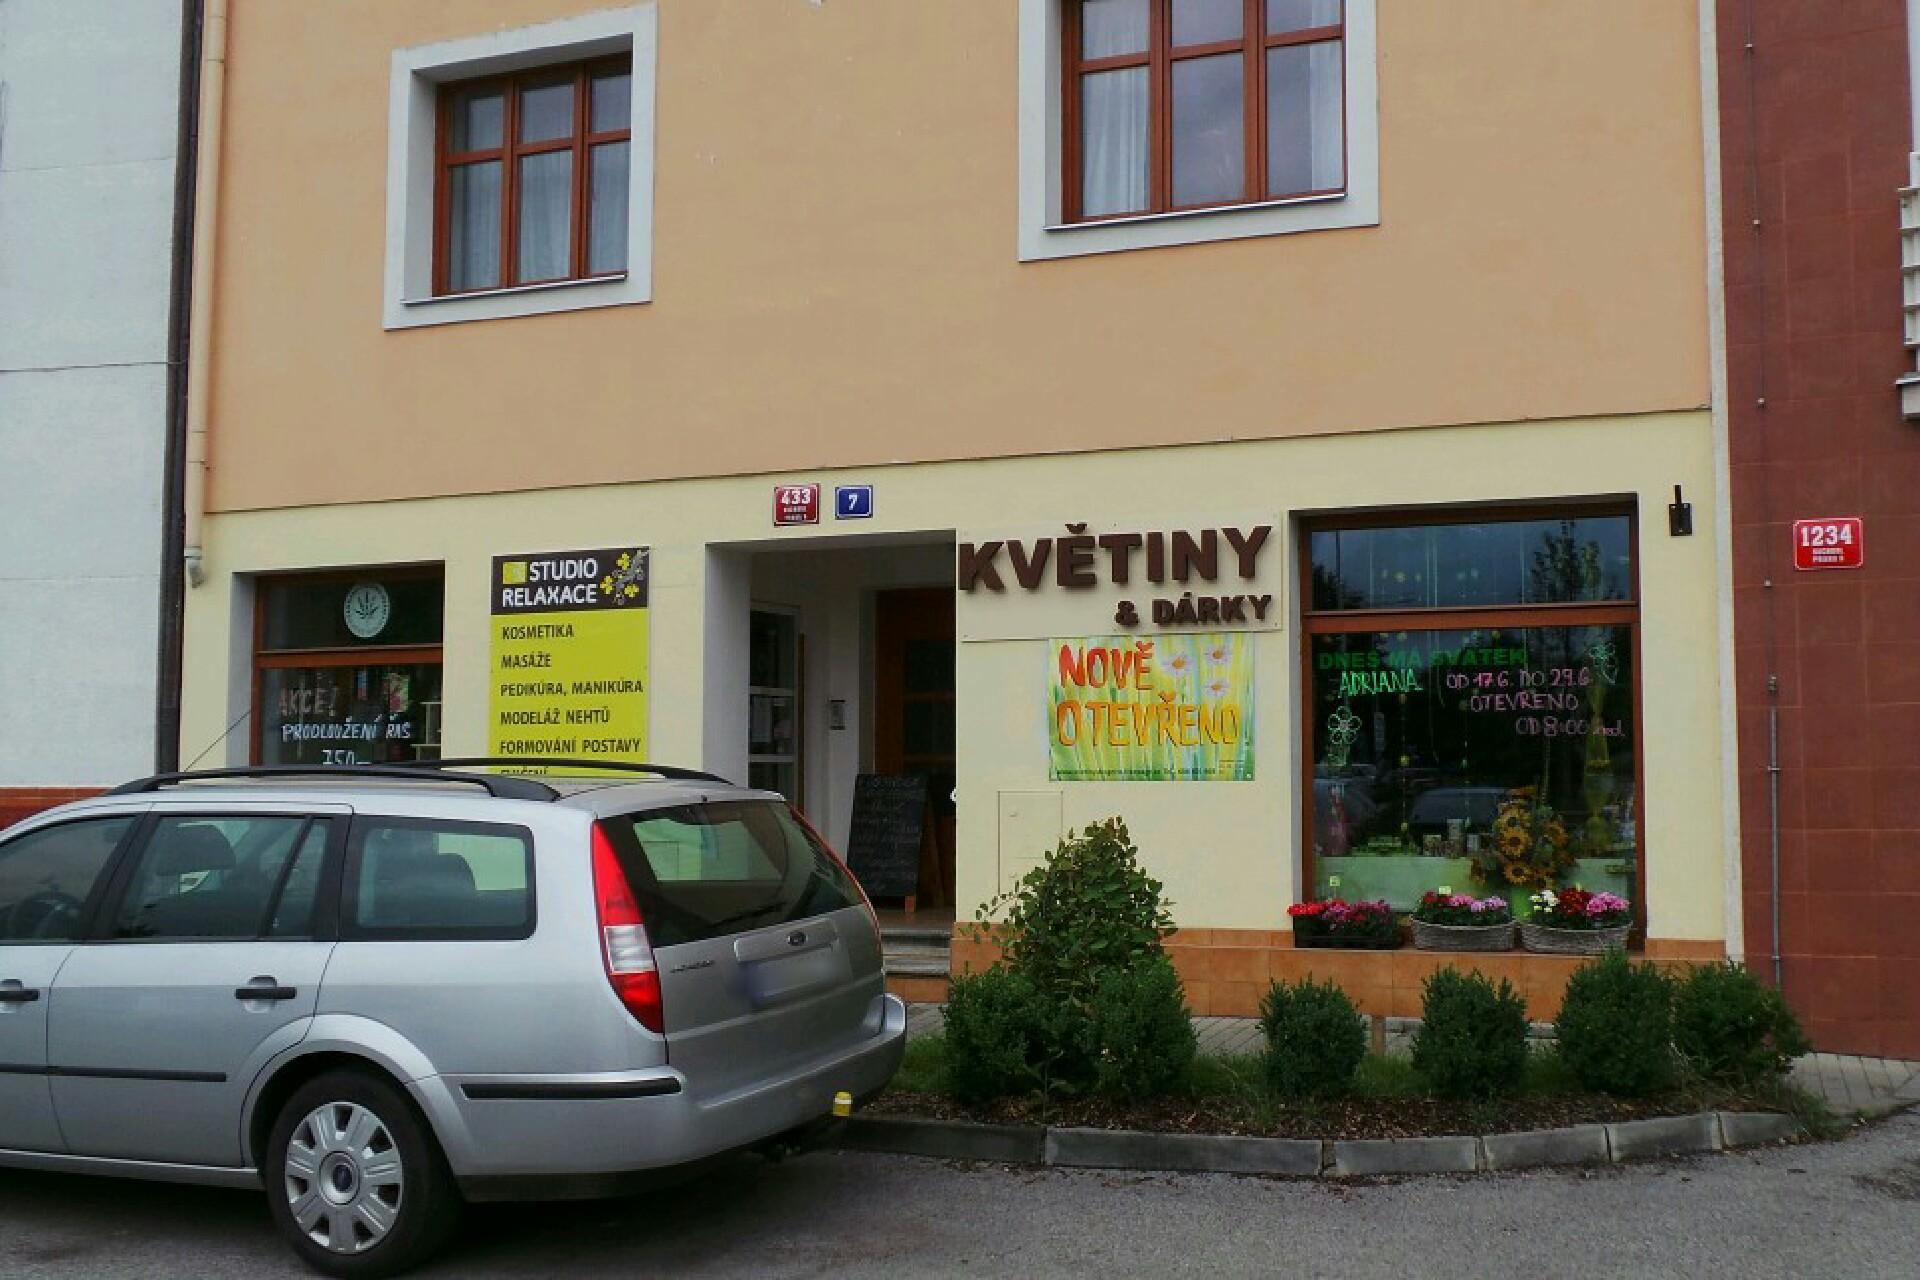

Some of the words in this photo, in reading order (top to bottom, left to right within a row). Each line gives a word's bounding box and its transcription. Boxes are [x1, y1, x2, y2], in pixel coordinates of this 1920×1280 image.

[782, 488, 811, 505] 433
[848, 493, 858, 511] 7
[1801, 523, 1852, 547] 1234
[959, 522, 1272, 592] KVĚTINY
[529, 557, 599, 582] STUDIO
[502, 583, 598, 608] RELAXACE
[1114, 600, 1139, 626] &
[1152, 591, 1272, 625] DÁRKY
[502, 624, 574, 640] KOSMETIKA
[501, 651, 552, 669] MASÁŽE
[1058, 640, 1155, 691] NOVĚ
[501, 679, 567, 697] PEDIKÚRA,
[572, 677, 644, 695] MANIKÚRA
[501, 708, 561, 725] MODELÁŽ
[566, 706, 611, 724] NEHTŮ
[1057, 691, 1240, 747] OTEVŘENO
[501, 736, 577, 754] FORMOVÁNÍ
[582, 737, 641, 753] POSTAVY
